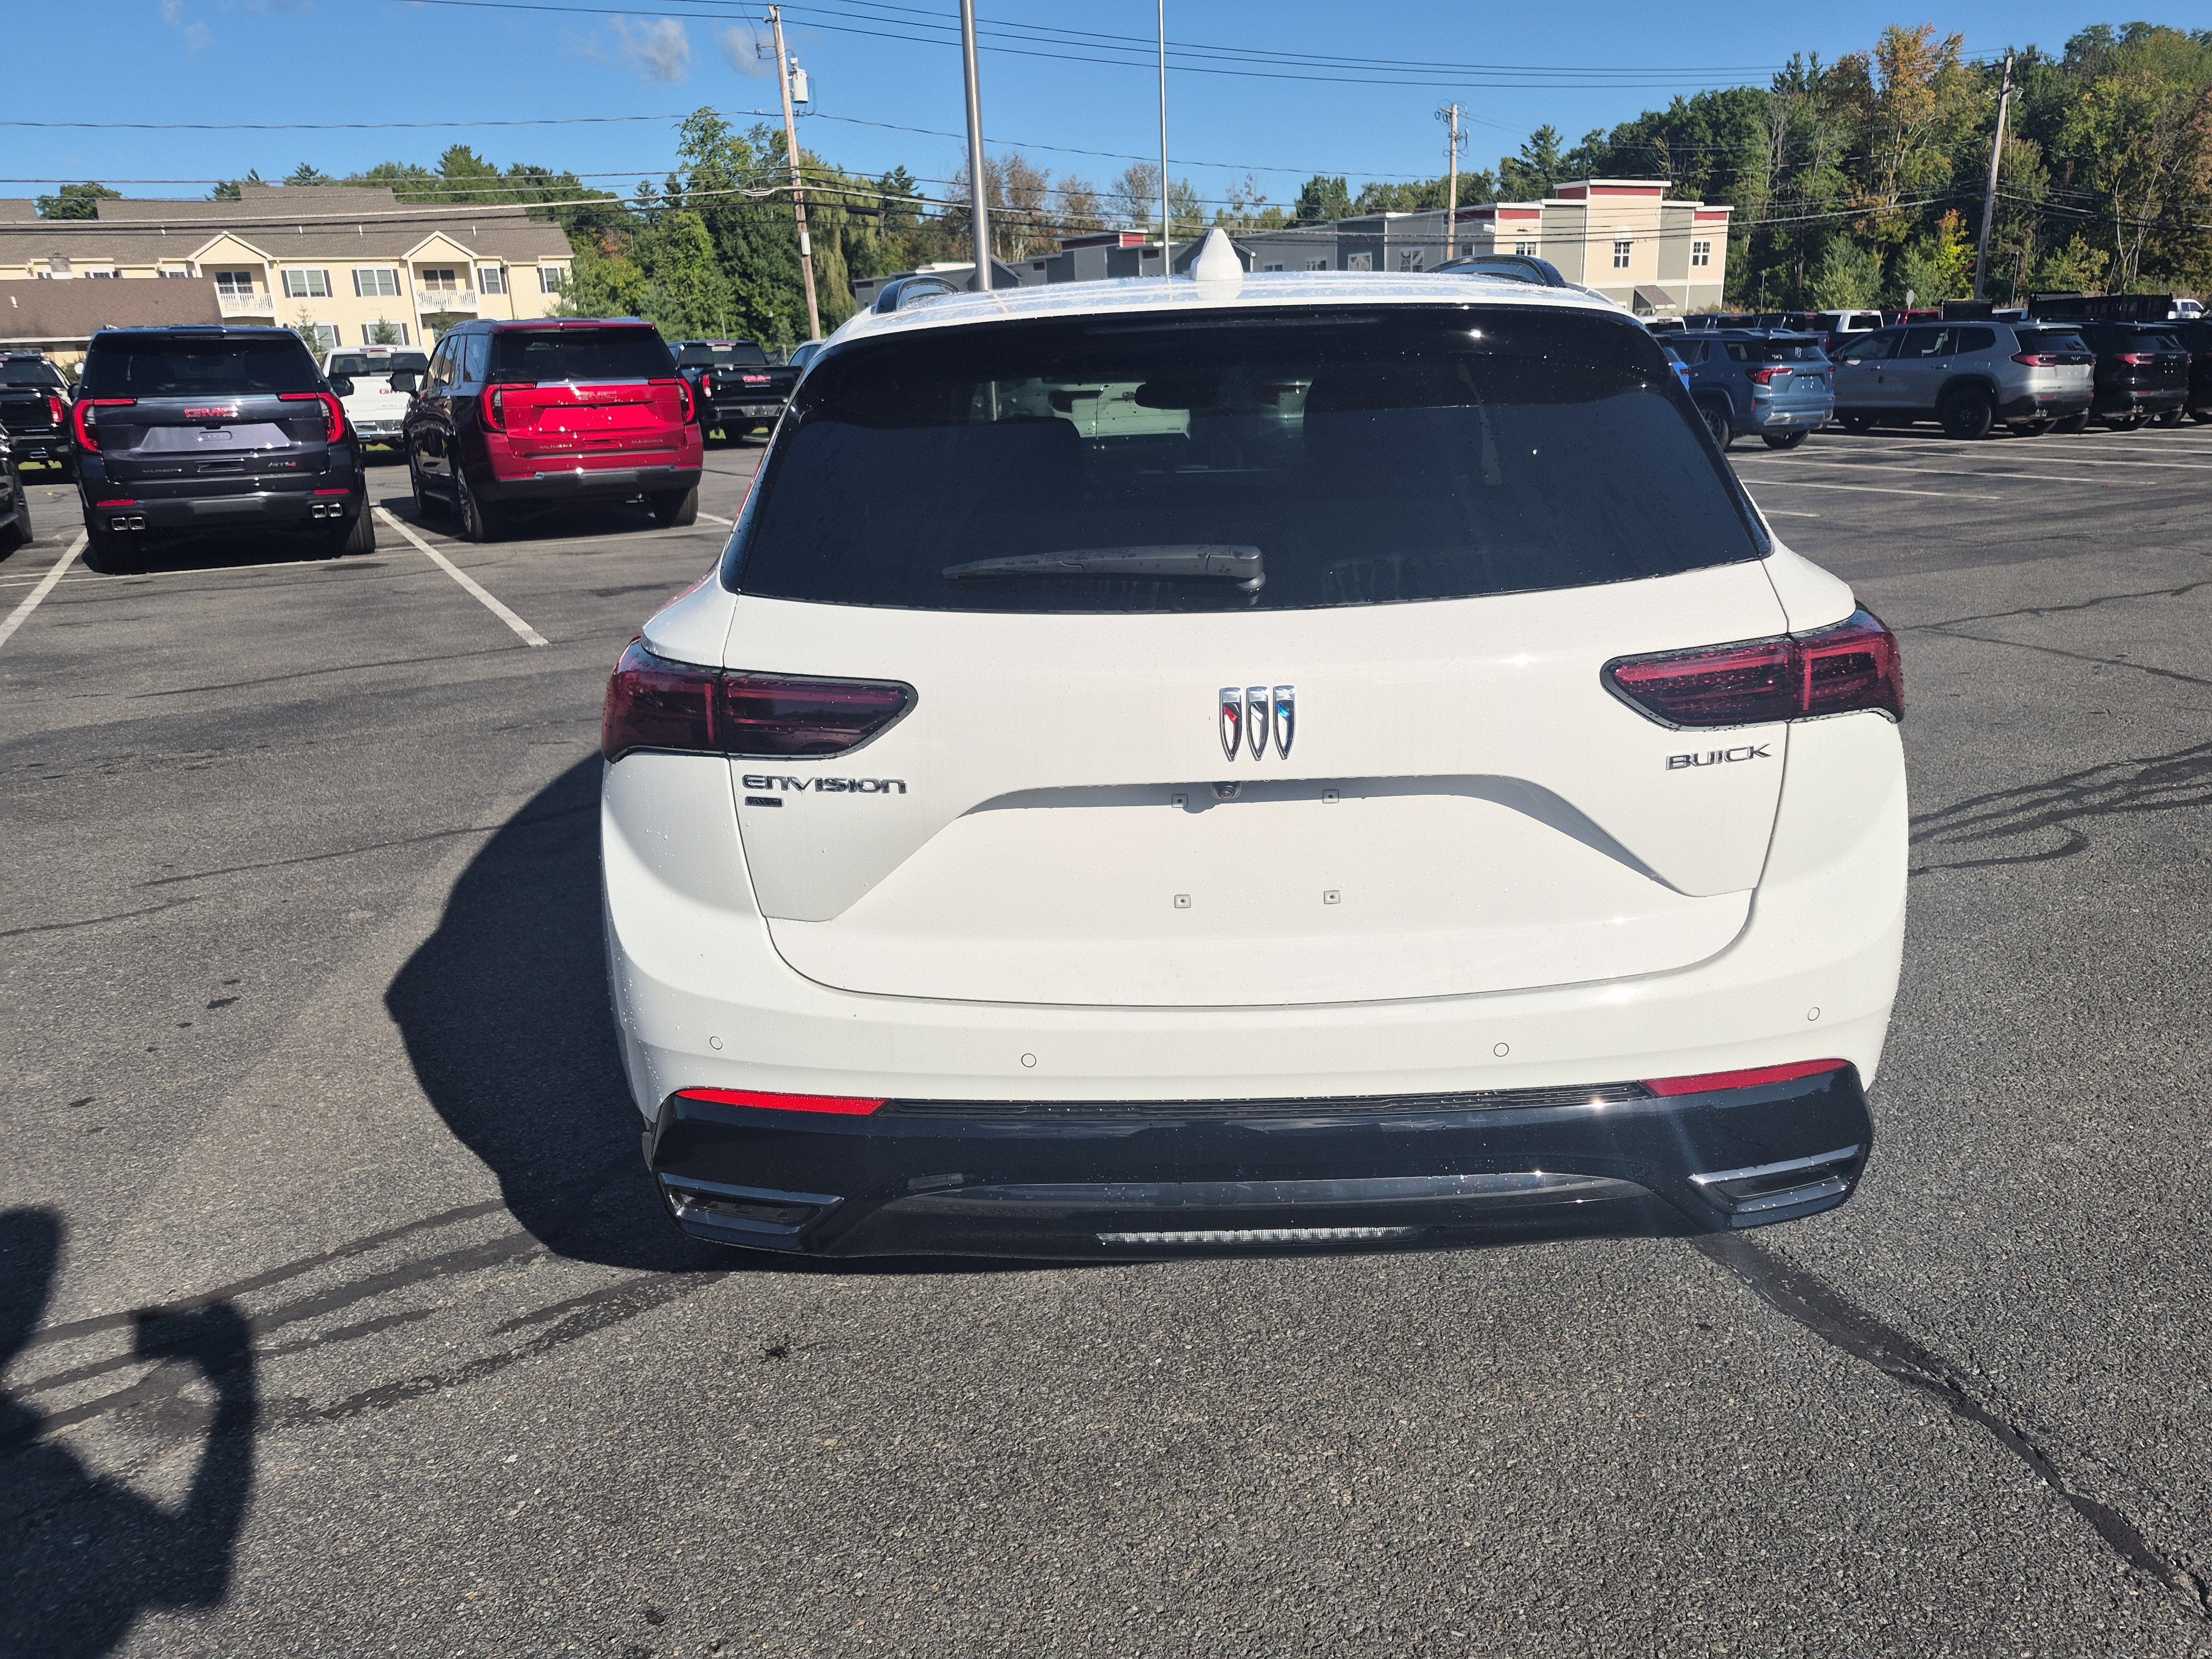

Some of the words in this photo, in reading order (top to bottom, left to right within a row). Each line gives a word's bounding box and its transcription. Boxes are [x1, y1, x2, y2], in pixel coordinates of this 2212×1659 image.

[184, 408, 237, 417] GMC
[1666, 743, 1772, 770] BUICK
[742, 774, 907, 794] ENVISION
